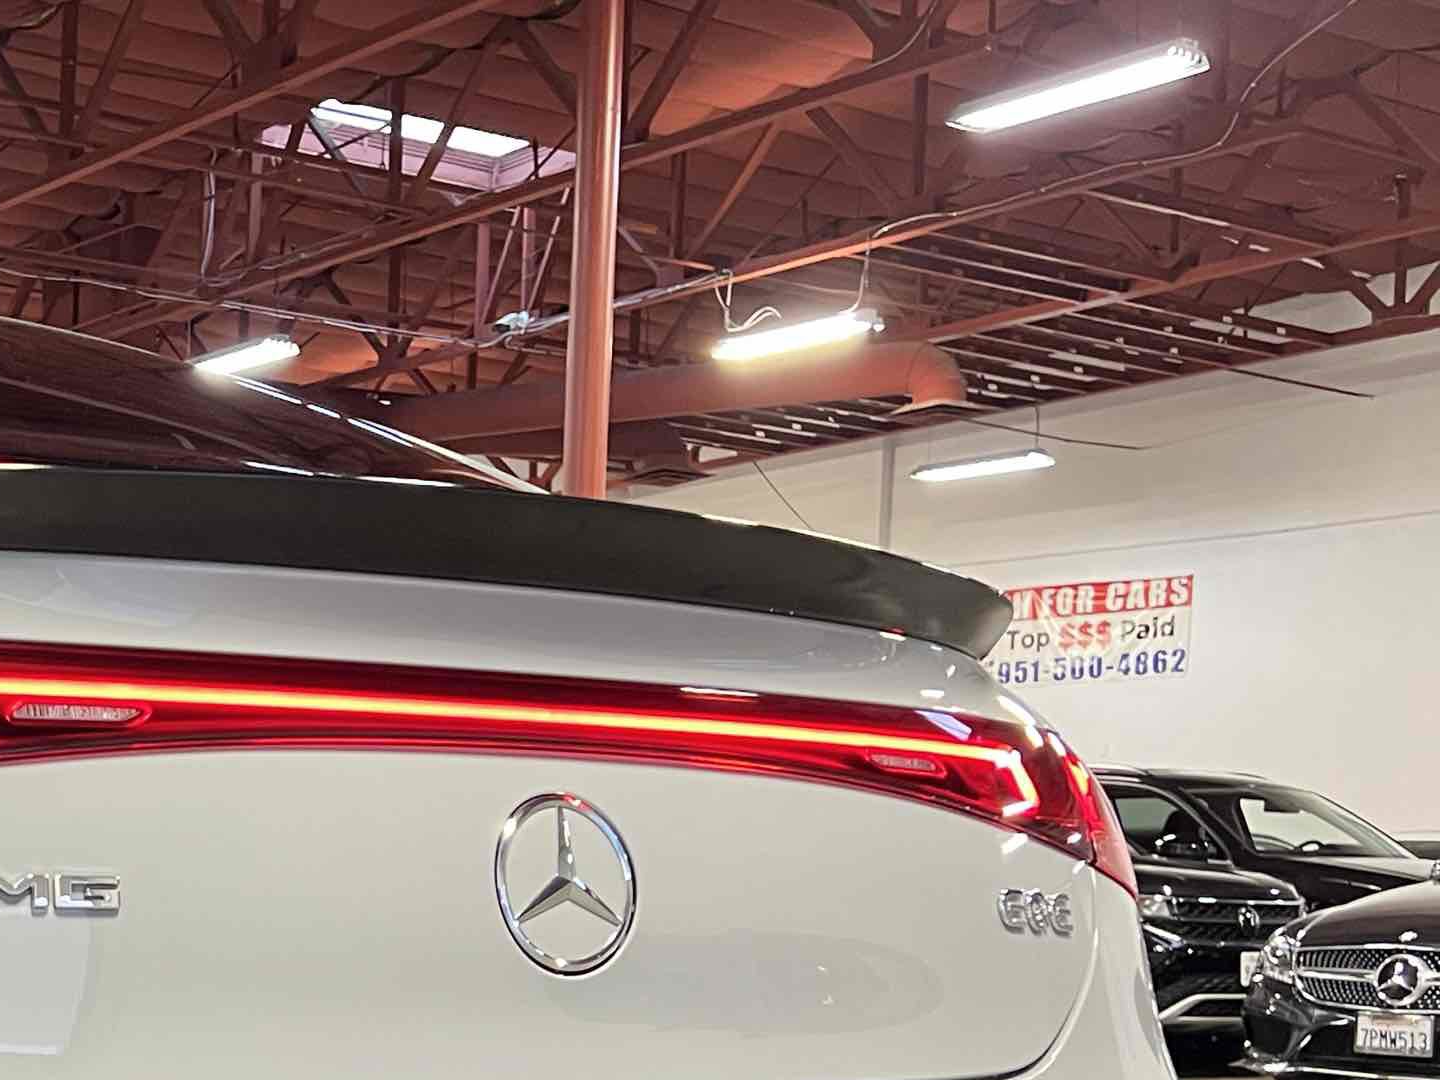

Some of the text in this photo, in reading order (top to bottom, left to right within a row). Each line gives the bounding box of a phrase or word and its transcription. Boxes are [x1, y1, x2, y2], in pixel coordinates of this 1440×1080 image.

[1042, 584, 1095, 618] FOR
[1105, 577, 1189, 613] CARS
[1007, 615, 1176, 652] Top $$$ Paid
[1360, 1027, 1428, 1052] 7PMW513
